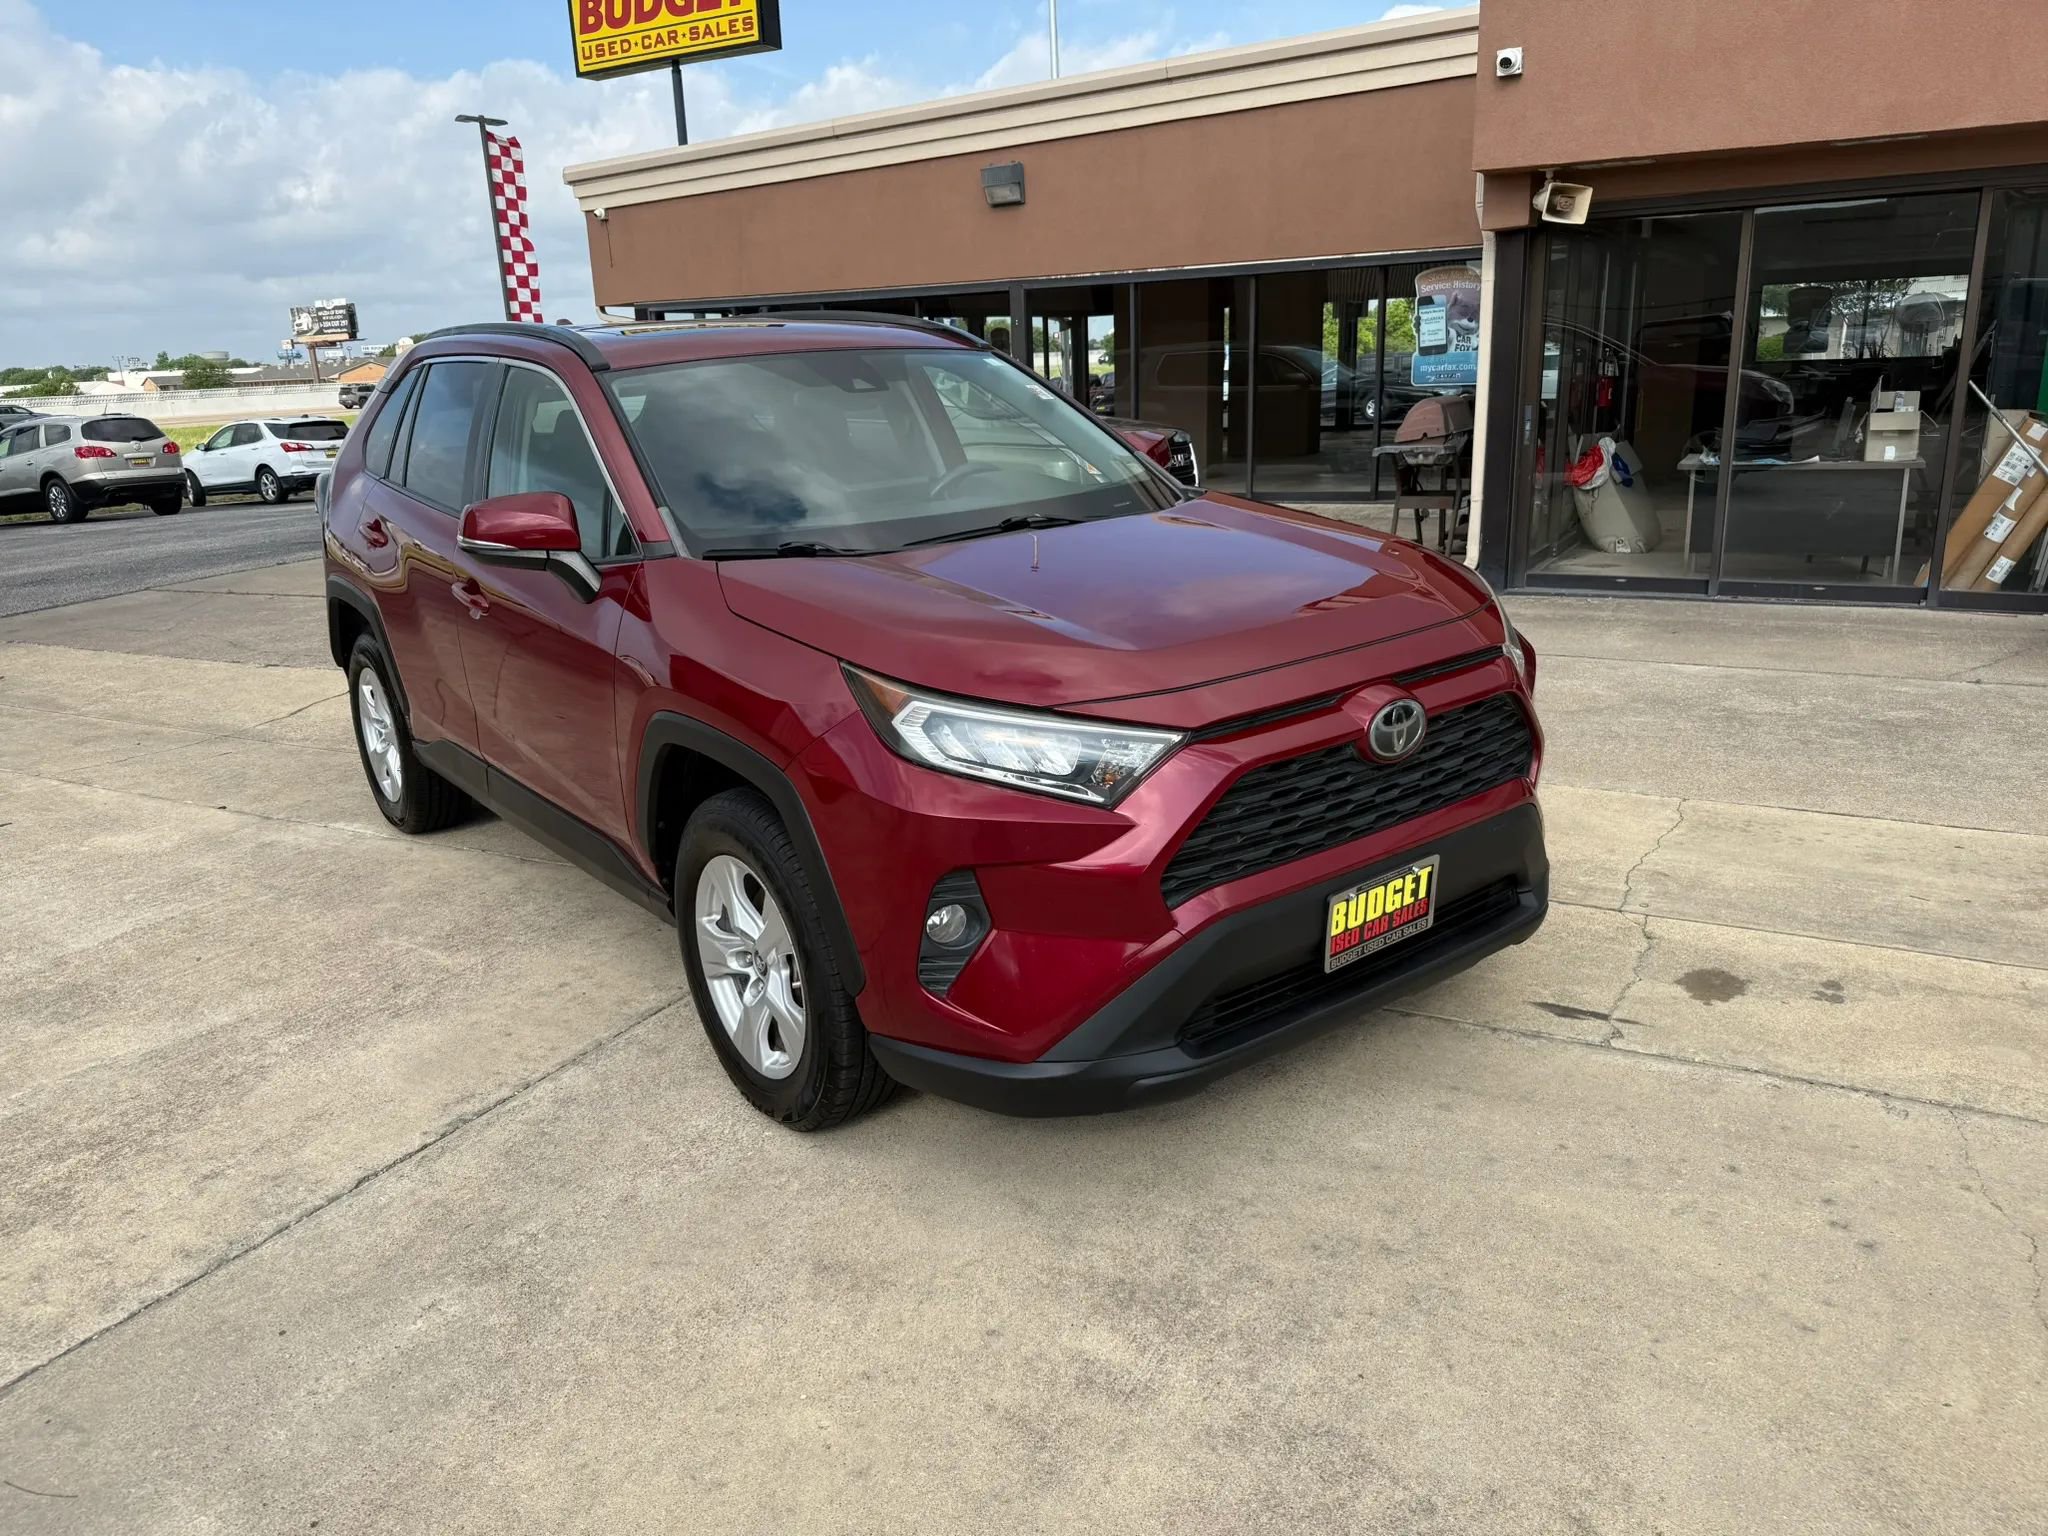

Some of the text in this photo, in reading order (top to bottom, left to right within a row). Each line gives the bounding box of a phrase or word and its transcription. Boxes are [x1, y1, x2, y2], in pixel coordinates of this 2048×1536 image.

[579, 0, 741, 35] BUD
[582, 16, 754, 61] USED CAR SALES
[1420, 280, 1482, 293] Service History
[1455, 344, 1471, 352] FOX
[1456, 335, 1472, 344] CAR
[1420, 363, 1476, 373] mycarfax.com
[1330, 865, 1432, 937] BUDGET
[1364, 915, 1389, 940] CAR
[1392, 897, 1428, 928] SALES
[1331, 919, 1427, 969] BUDGET USED CAR SALES
